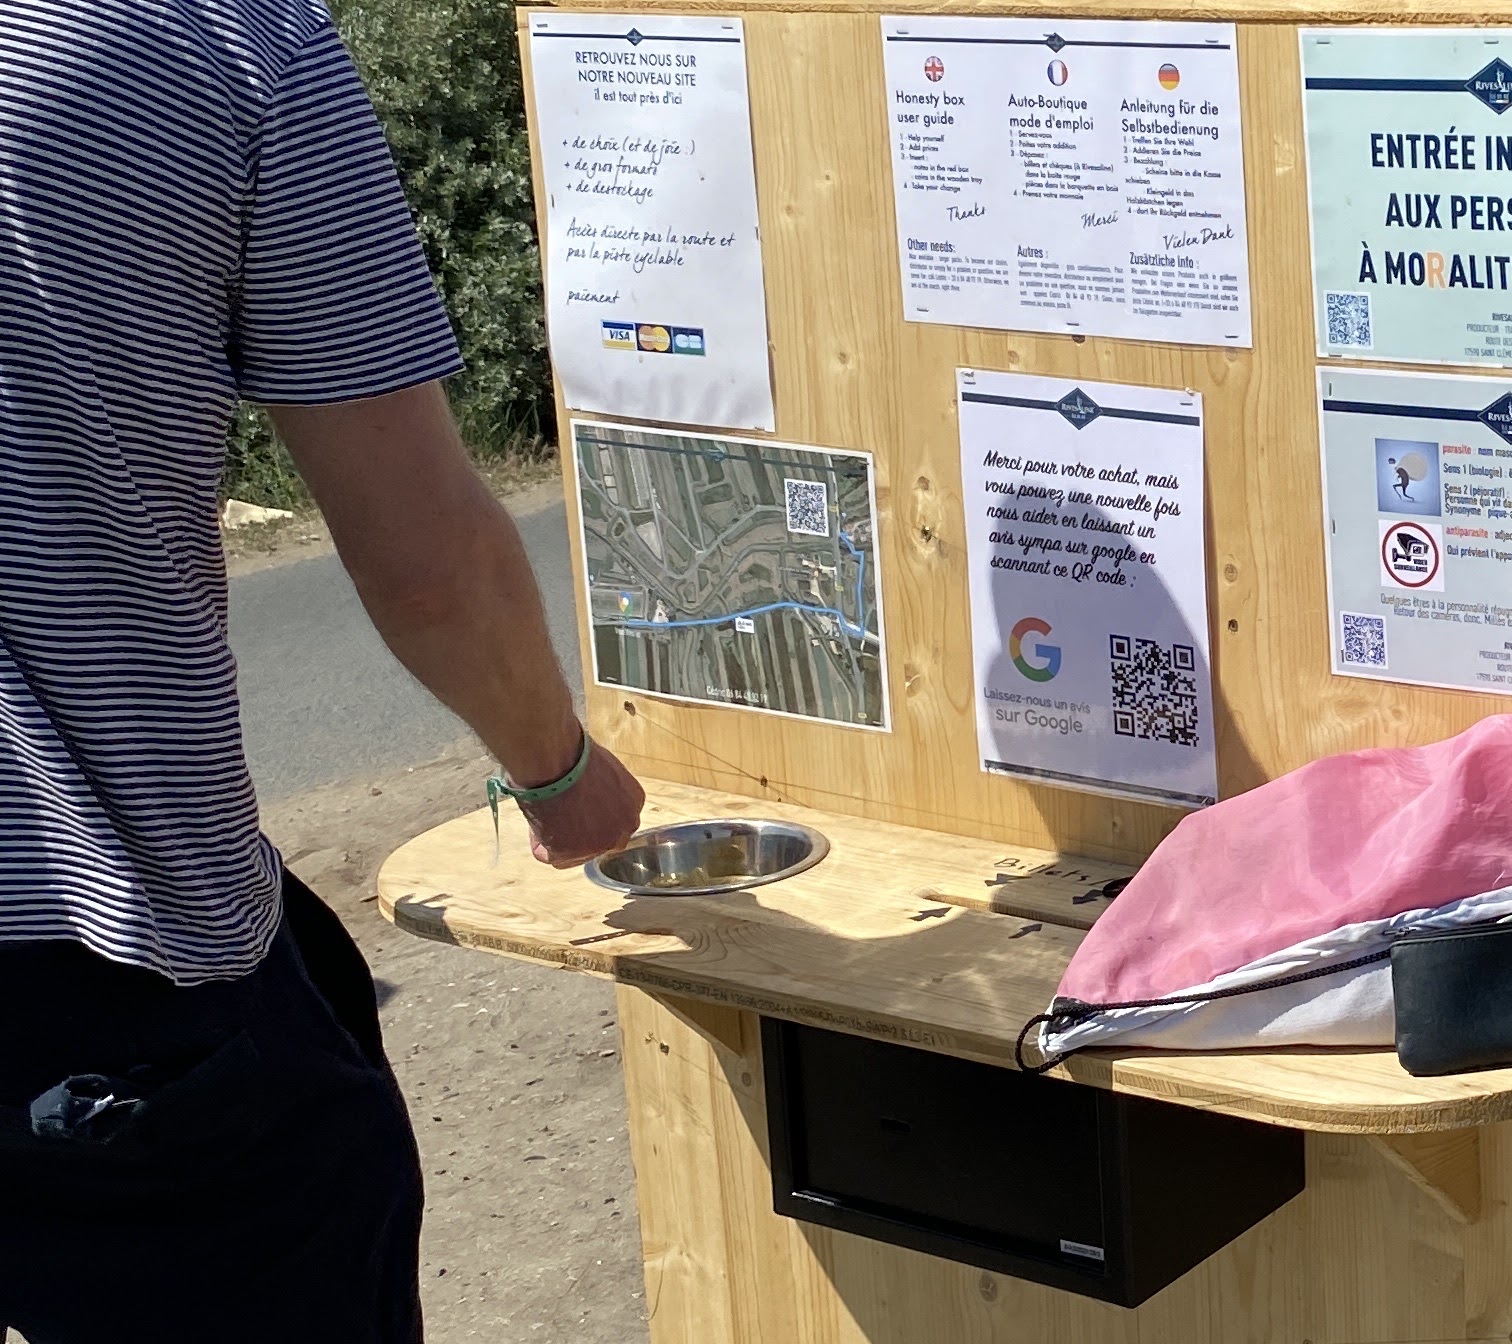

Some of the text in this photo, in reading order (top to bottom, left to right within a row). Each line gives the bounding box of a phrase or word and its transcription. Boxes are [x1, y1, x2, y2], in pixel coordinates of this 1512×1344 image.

[575, 51, 696, 67] RETROUVEZ NOUS SUR
[579, 70, 696, 86] NOTRE NOUVEAU SITE
[594, 88, 682, 106] il est tout près d'ici
[896, 90, 965, 108] Honesty box
[1008, 94, 1087, 113] Auto-Boutique
[1120, 98, 1219, 118] Anleitung für die
[897, 111, 954, 127] user guide
[1010, 113, 1094, 133] mode d'emploi
[1122, 118, 1219, 140] Selbstbedienung
[572, 136, 587, 148] de
[1371, 126, 1476, 170] ENTRÉE
[574, 158, 588, 171] de
[576, 180, 589, 192] de
[946, 202, 986, 221] Thanks
[1385, 193, 1442, 229] AUX
[642, 231, 662, 247] par
[666, 226, 678, 244] la
[682, 231, 716, 246] route
[720, 233, 736, 247] et
[1163, 224, 1234, 250] Vielen Dank
[566, 246, 586, 262] par
[589, 242, 600, 259] la
[1017, 245, 1043, 258] Autres
[1359, 241, 1377, 283] À
[609, 329, 630, 341] VISA
[983, 450, 1179, 490] Merci pour votre achat, mais
[985, 481, 1181, 521] vous pouvez une nouvelle fois
[987, 505, 1156, 539] nous aider en laissant un
[989, 531, 1156, 567] avis sympa sur google en
[990, 555, 1126, 586] scannant ce QR code
[984, 687, 1091, 714] Laissez-nous un avis
[996, 709, 1083, 735] sur Google
[994, 858, 1091, 882] Billets
